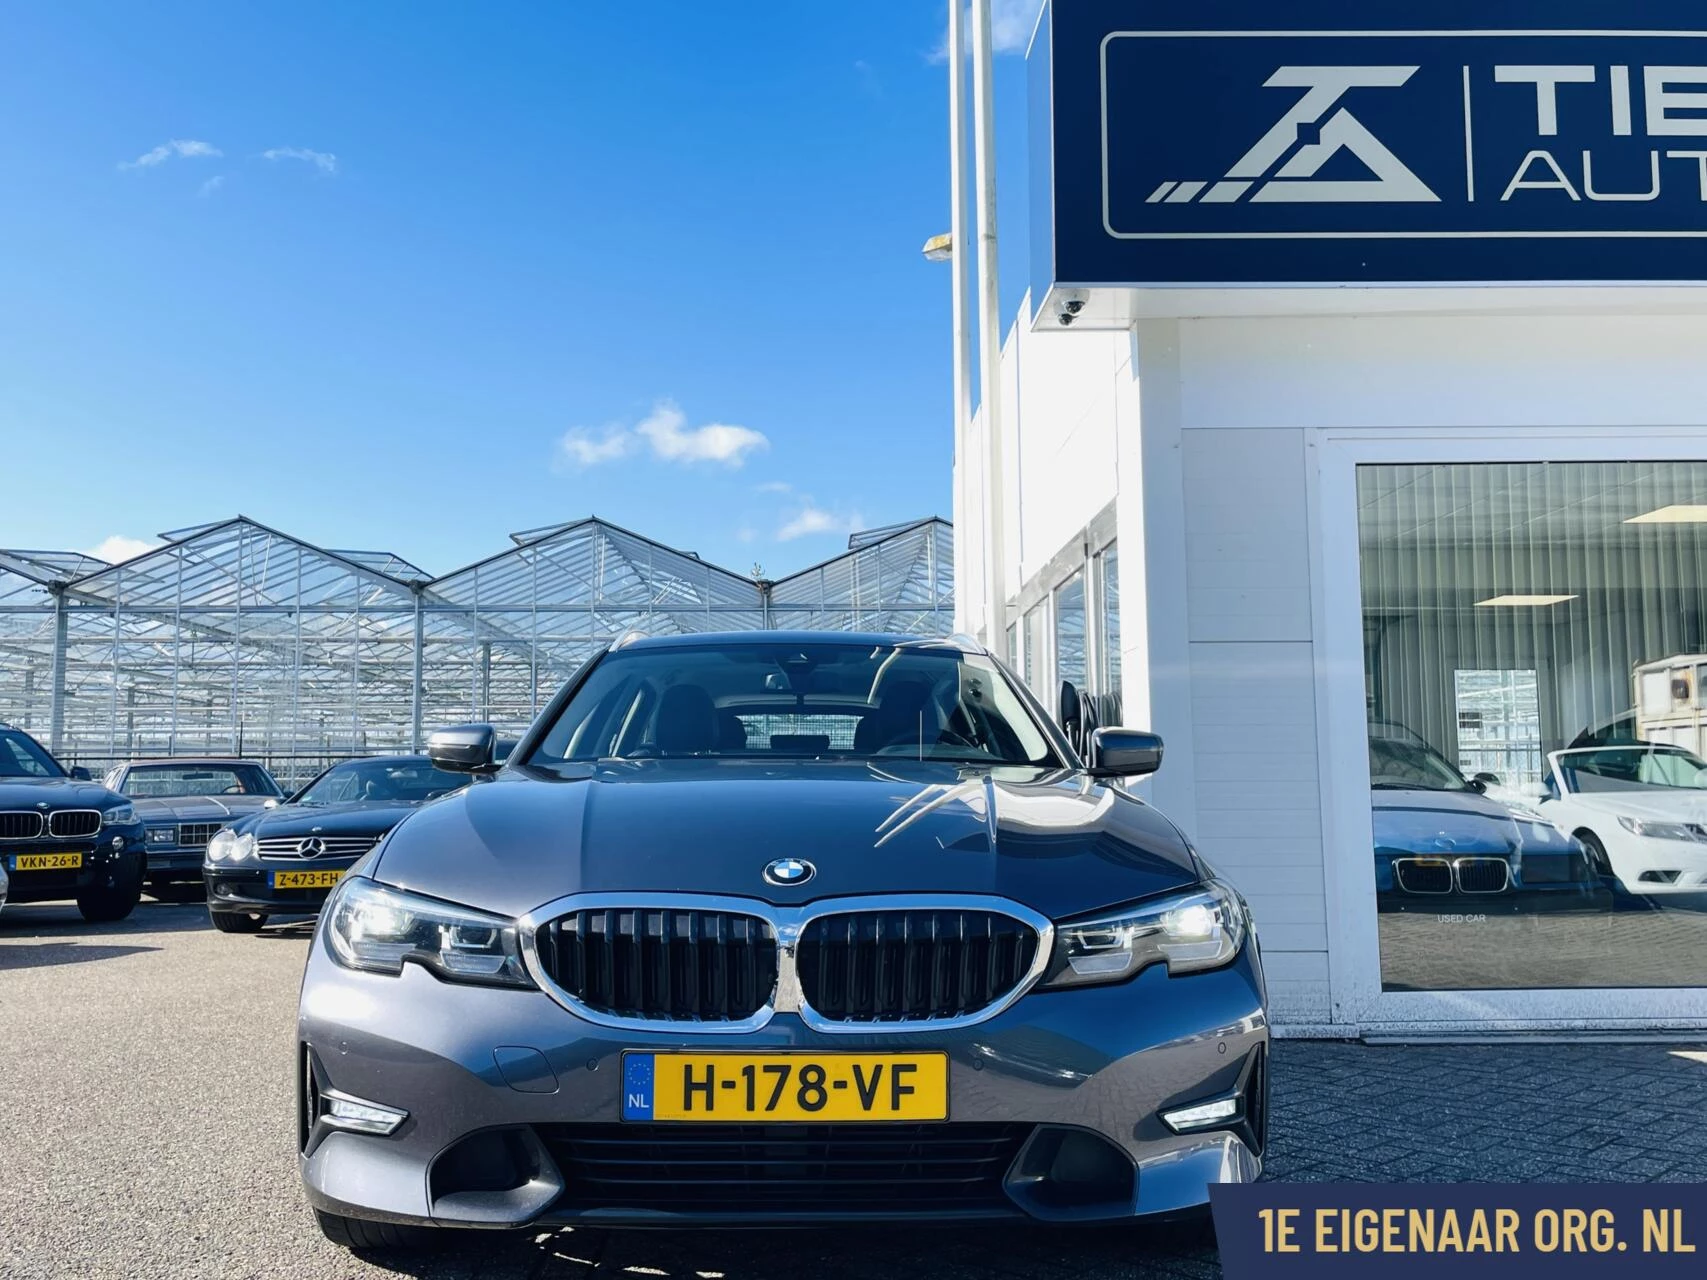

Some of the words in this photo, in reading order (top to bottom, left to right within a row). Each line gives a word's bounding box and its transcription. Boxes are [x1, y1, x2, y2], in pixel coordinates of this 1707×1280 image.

[1494, 65, 1707, 136] TIE
[21, 855, 79, 868] VKN-26-R
[279, 872, 339, 886] Z-473-FH
[1437, 914, 1463, 923] USED
[1465, 914, 1486, 922] CAR
[683, 1064, 918, 1112] H-178-VF
[628, 1093, 650, 1108] NL
